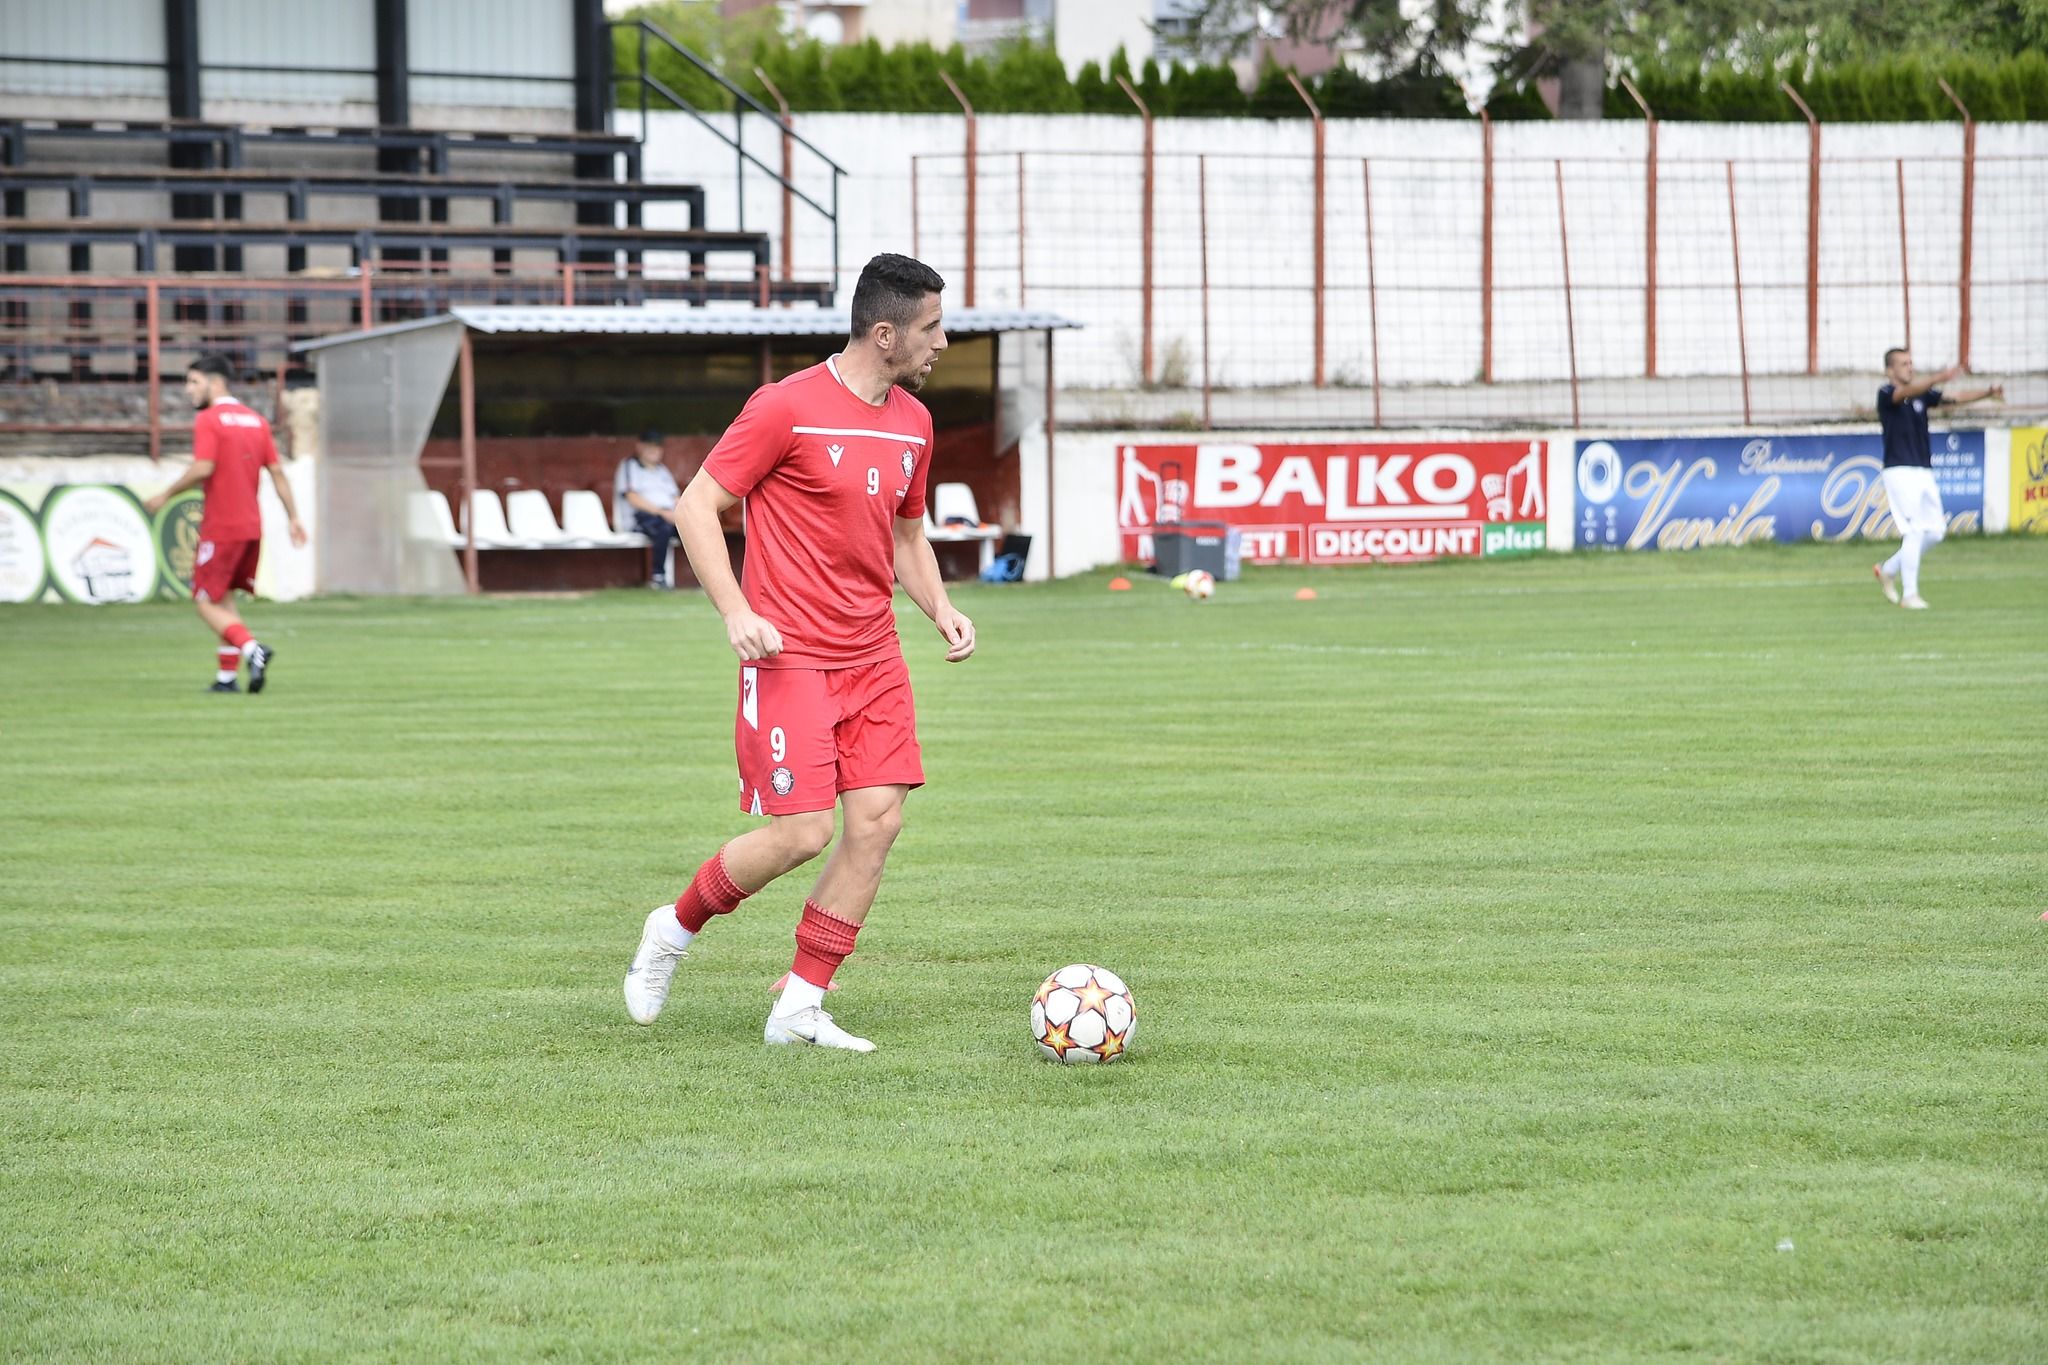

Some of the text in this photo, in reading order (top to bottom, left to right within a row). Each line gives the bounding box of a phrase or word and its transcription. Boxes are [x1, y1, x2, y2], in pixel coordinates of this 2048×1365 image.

[867, 467, 880, 495] 9
[1194, 445, 1477, 521] BALKO
[1623, 457, 1781, 550] Vanila
[1315, 528, 1476, 555] DISCOUNT
[1486, 526, 1544, 554] plus
[770, 726, 786, 763] 9
